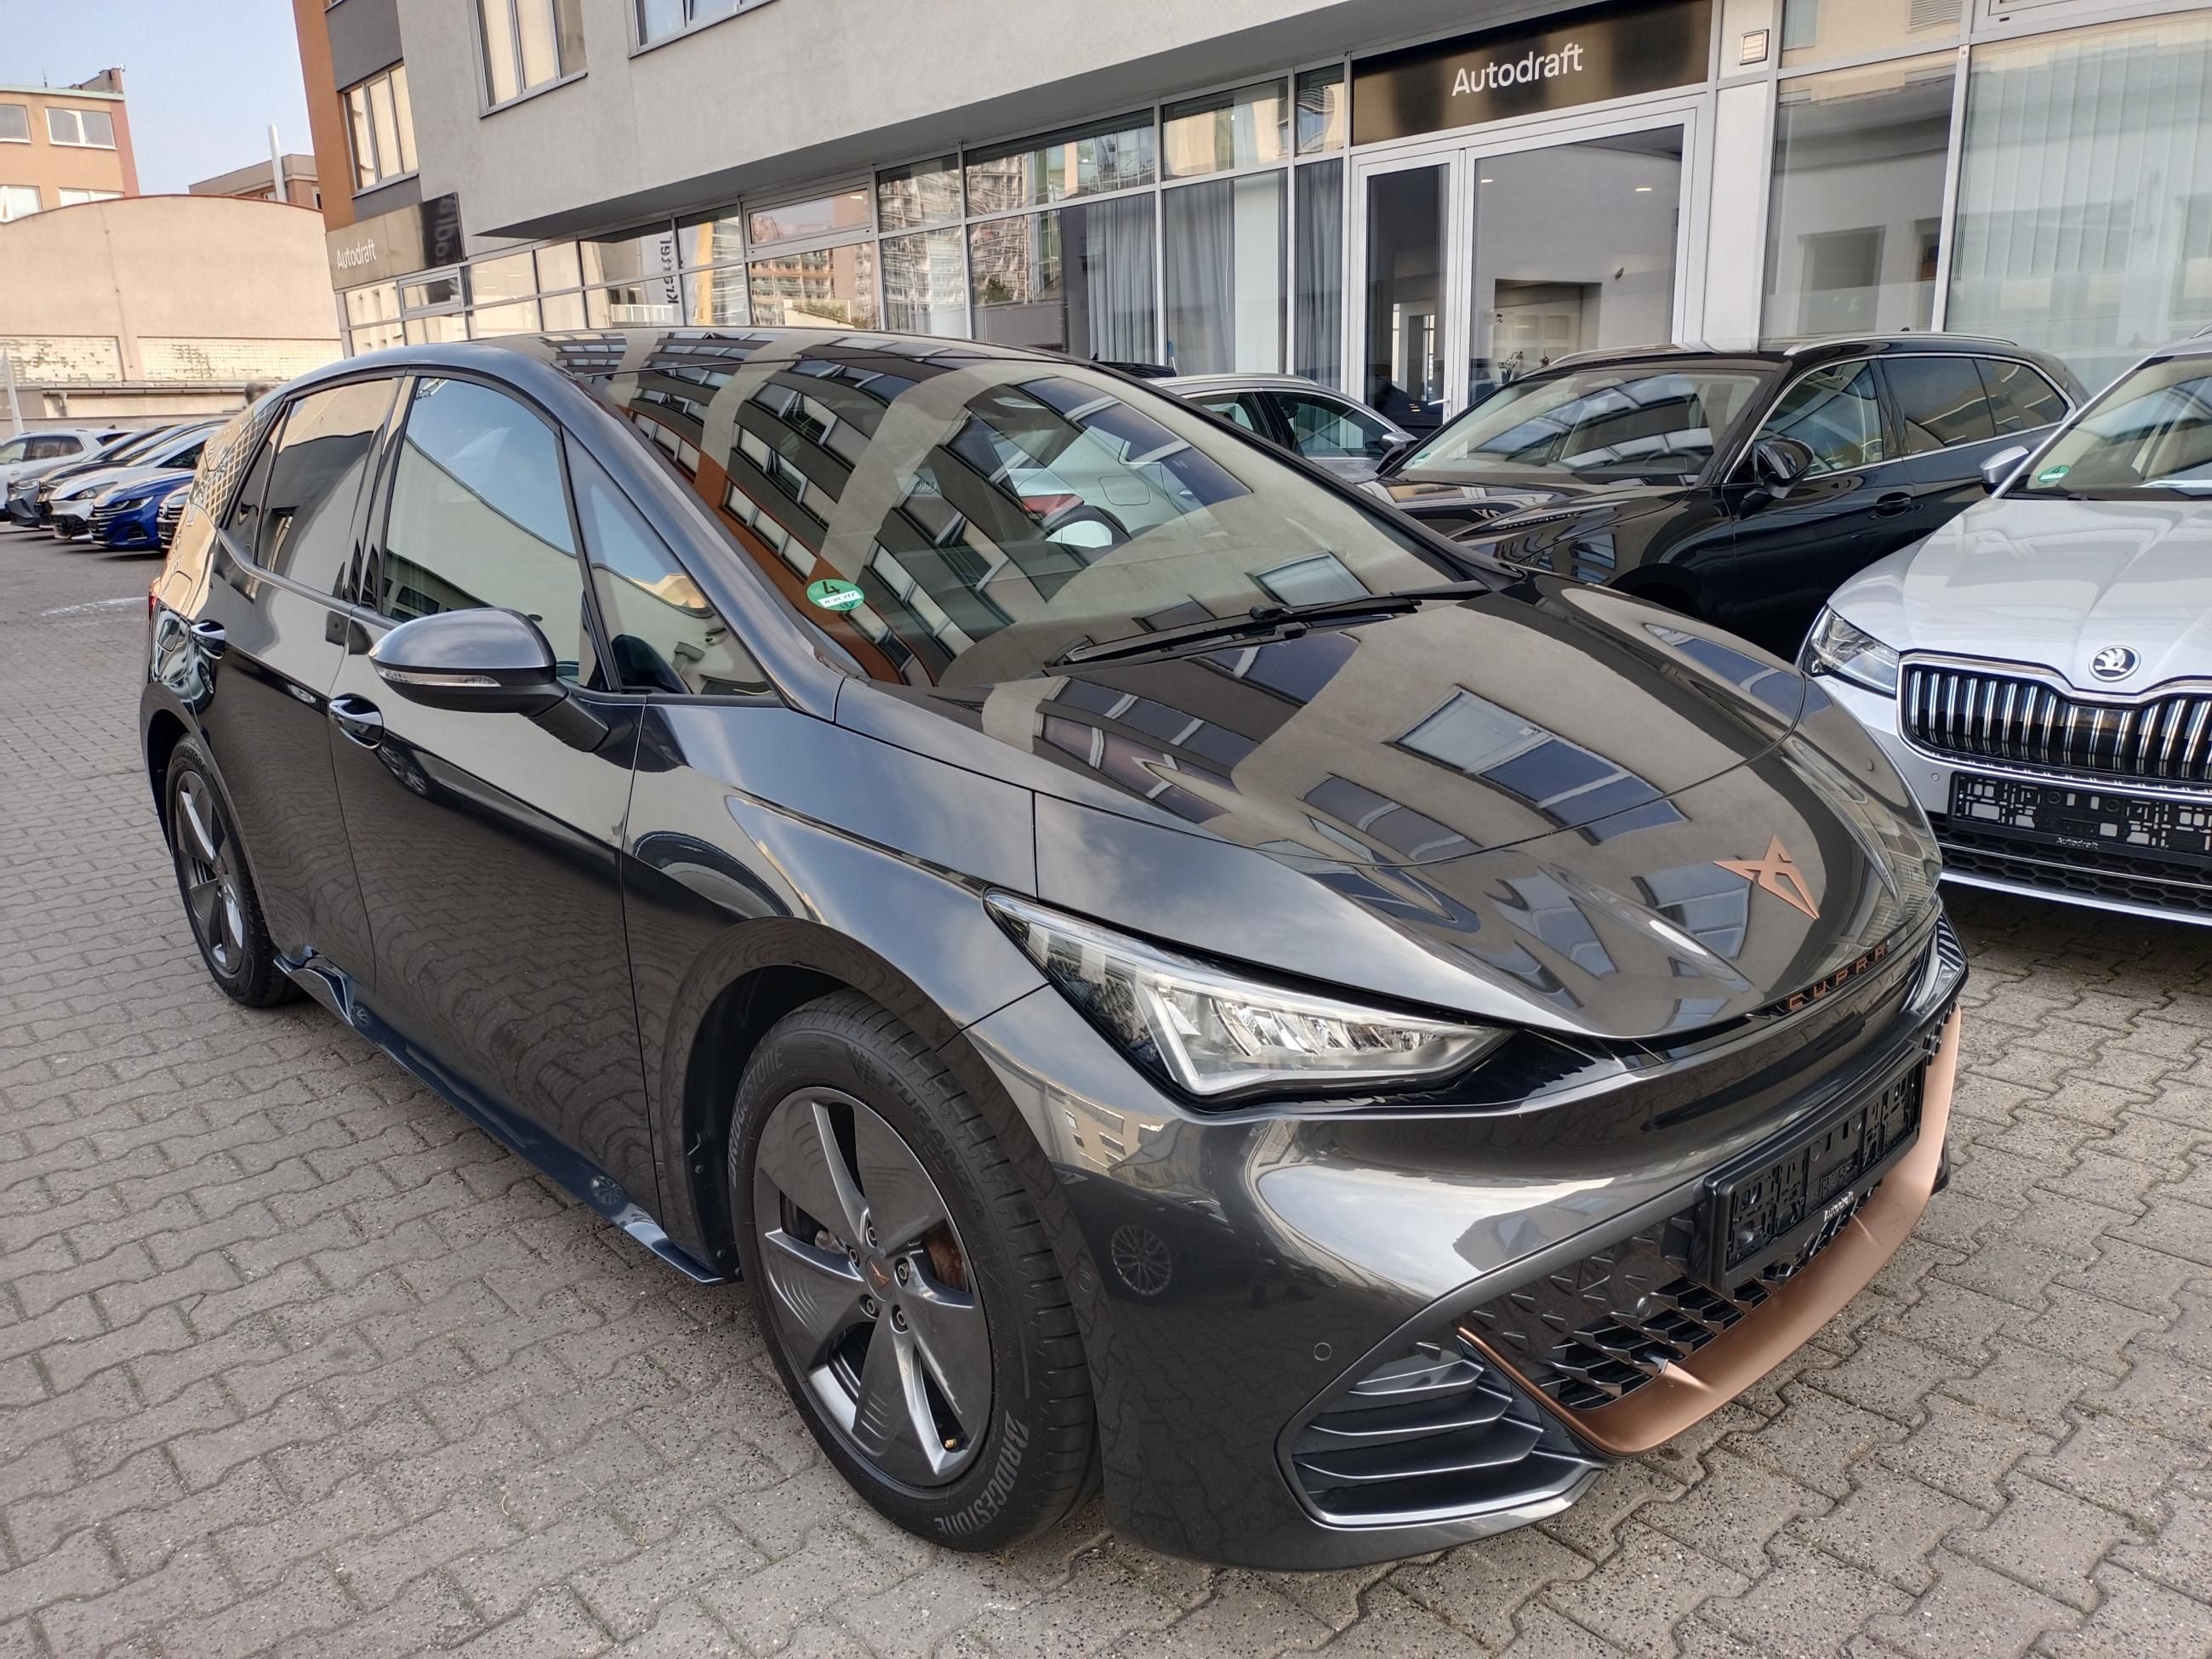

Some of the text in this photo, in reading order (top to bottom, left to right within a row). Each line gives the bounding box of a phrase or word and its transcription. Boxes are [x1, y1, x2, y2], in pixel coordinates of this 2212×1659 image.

[1451, 43, 1583, 97] Autodraft
[337, 238, 377, 270] Autodraft
[822, 580, 841, 595] 4
[2055, 836, 2099, 850] Autodraft
[1788, 944, 1886, 1012] CUPRA
[887, 1072, 984, 1218] TURANZA
[934, 1410, 1029, 1536] BRIDGESTONE
